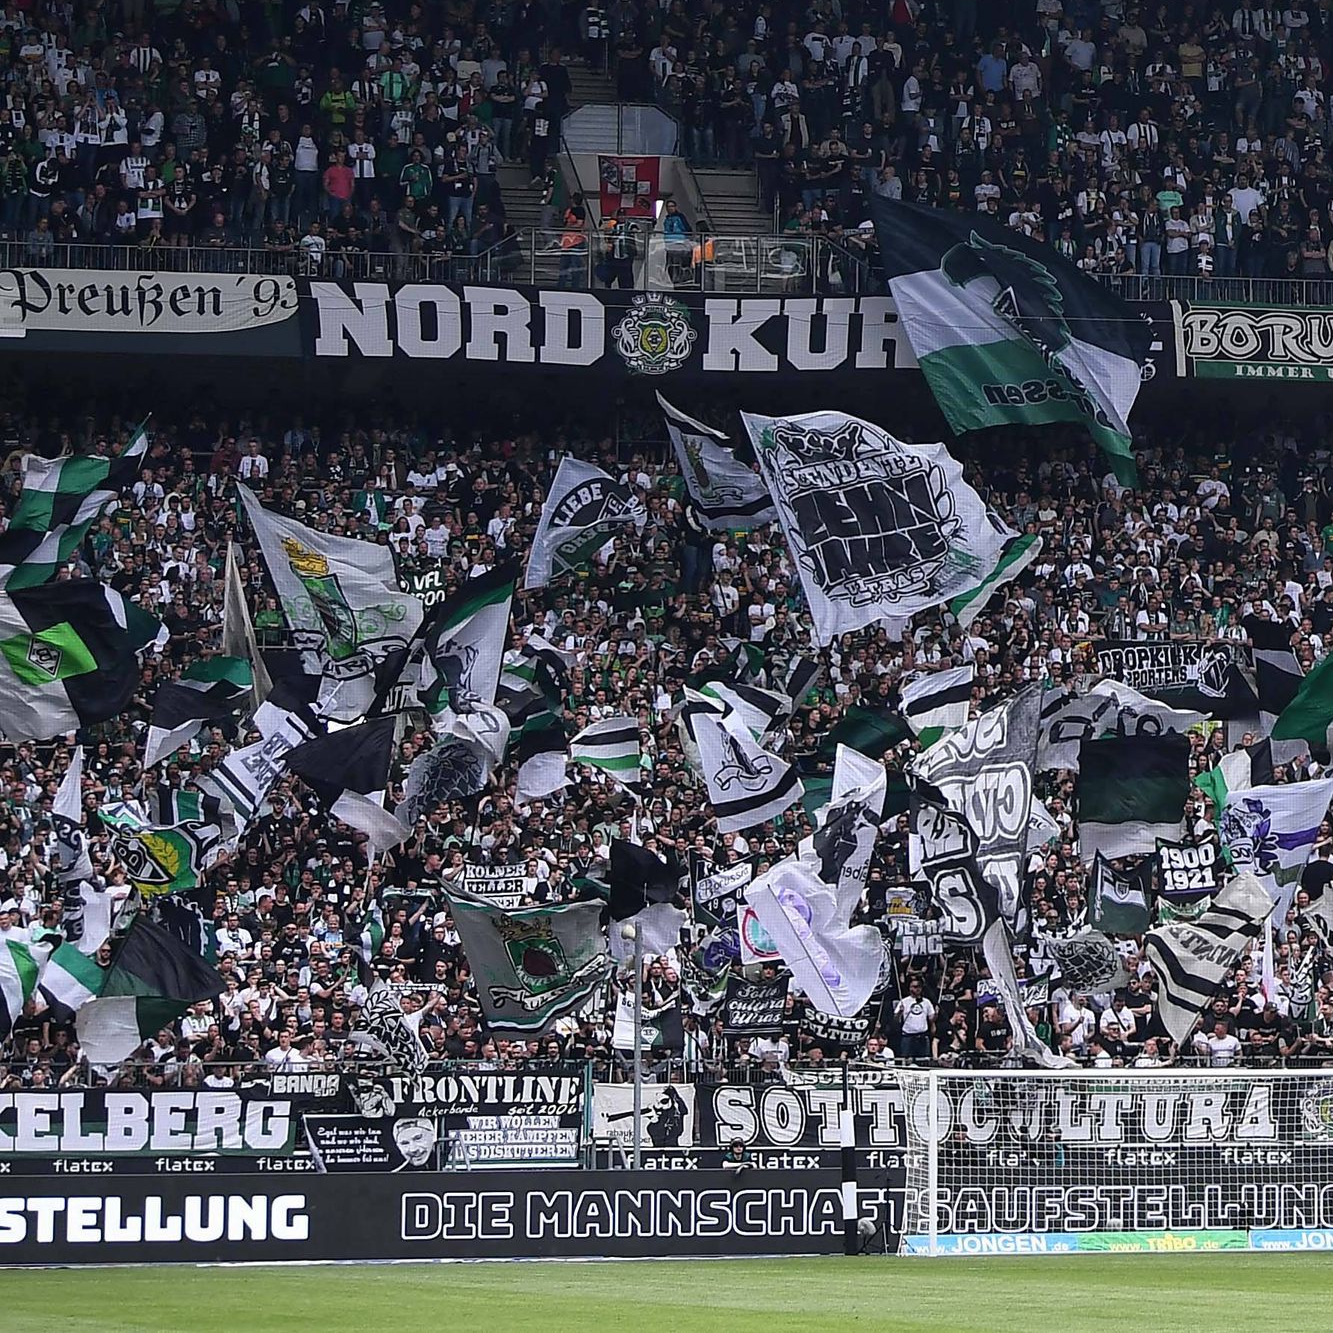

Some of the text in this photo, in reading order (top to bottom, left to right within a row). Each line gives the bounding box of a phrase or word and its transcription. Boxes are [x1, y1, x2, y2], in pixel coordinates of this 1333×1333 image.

[11, 266, 226, 331] Preußen
[316, 280, 606, 366] NORD
[703, 296, 922, 374] KUR
[1235, 364, 1315, 379] IMMER
[554, 482, 604, 528] LIEBE
[414, 571, 444, 591] VFL
[1125, 667, 1188, 688] PORTERS
[1161, 846, 1214, 870] 1900
[1165, 868, 1217, 891] 1921
[805, 1008, 869, 1030] SOTTO
[391, 1075, 584, 1106] FRONTLINE
[468, 1116, 561, 1130] WIR WOLLEN
[450, 1130, 504, 1144] IEBER
[54, 1159, 115, 1174] flatex
[156, 1157, 216, 1173] flatex
[257, 1156, 317, 1172] flatex
[627, 1154, 699, 1171] fatex
[1102, 1149, 1176, 1166] flatex
[1220, 1148, 1291, 1165] flatex
[402, 1192, 513, 1240] DIE
